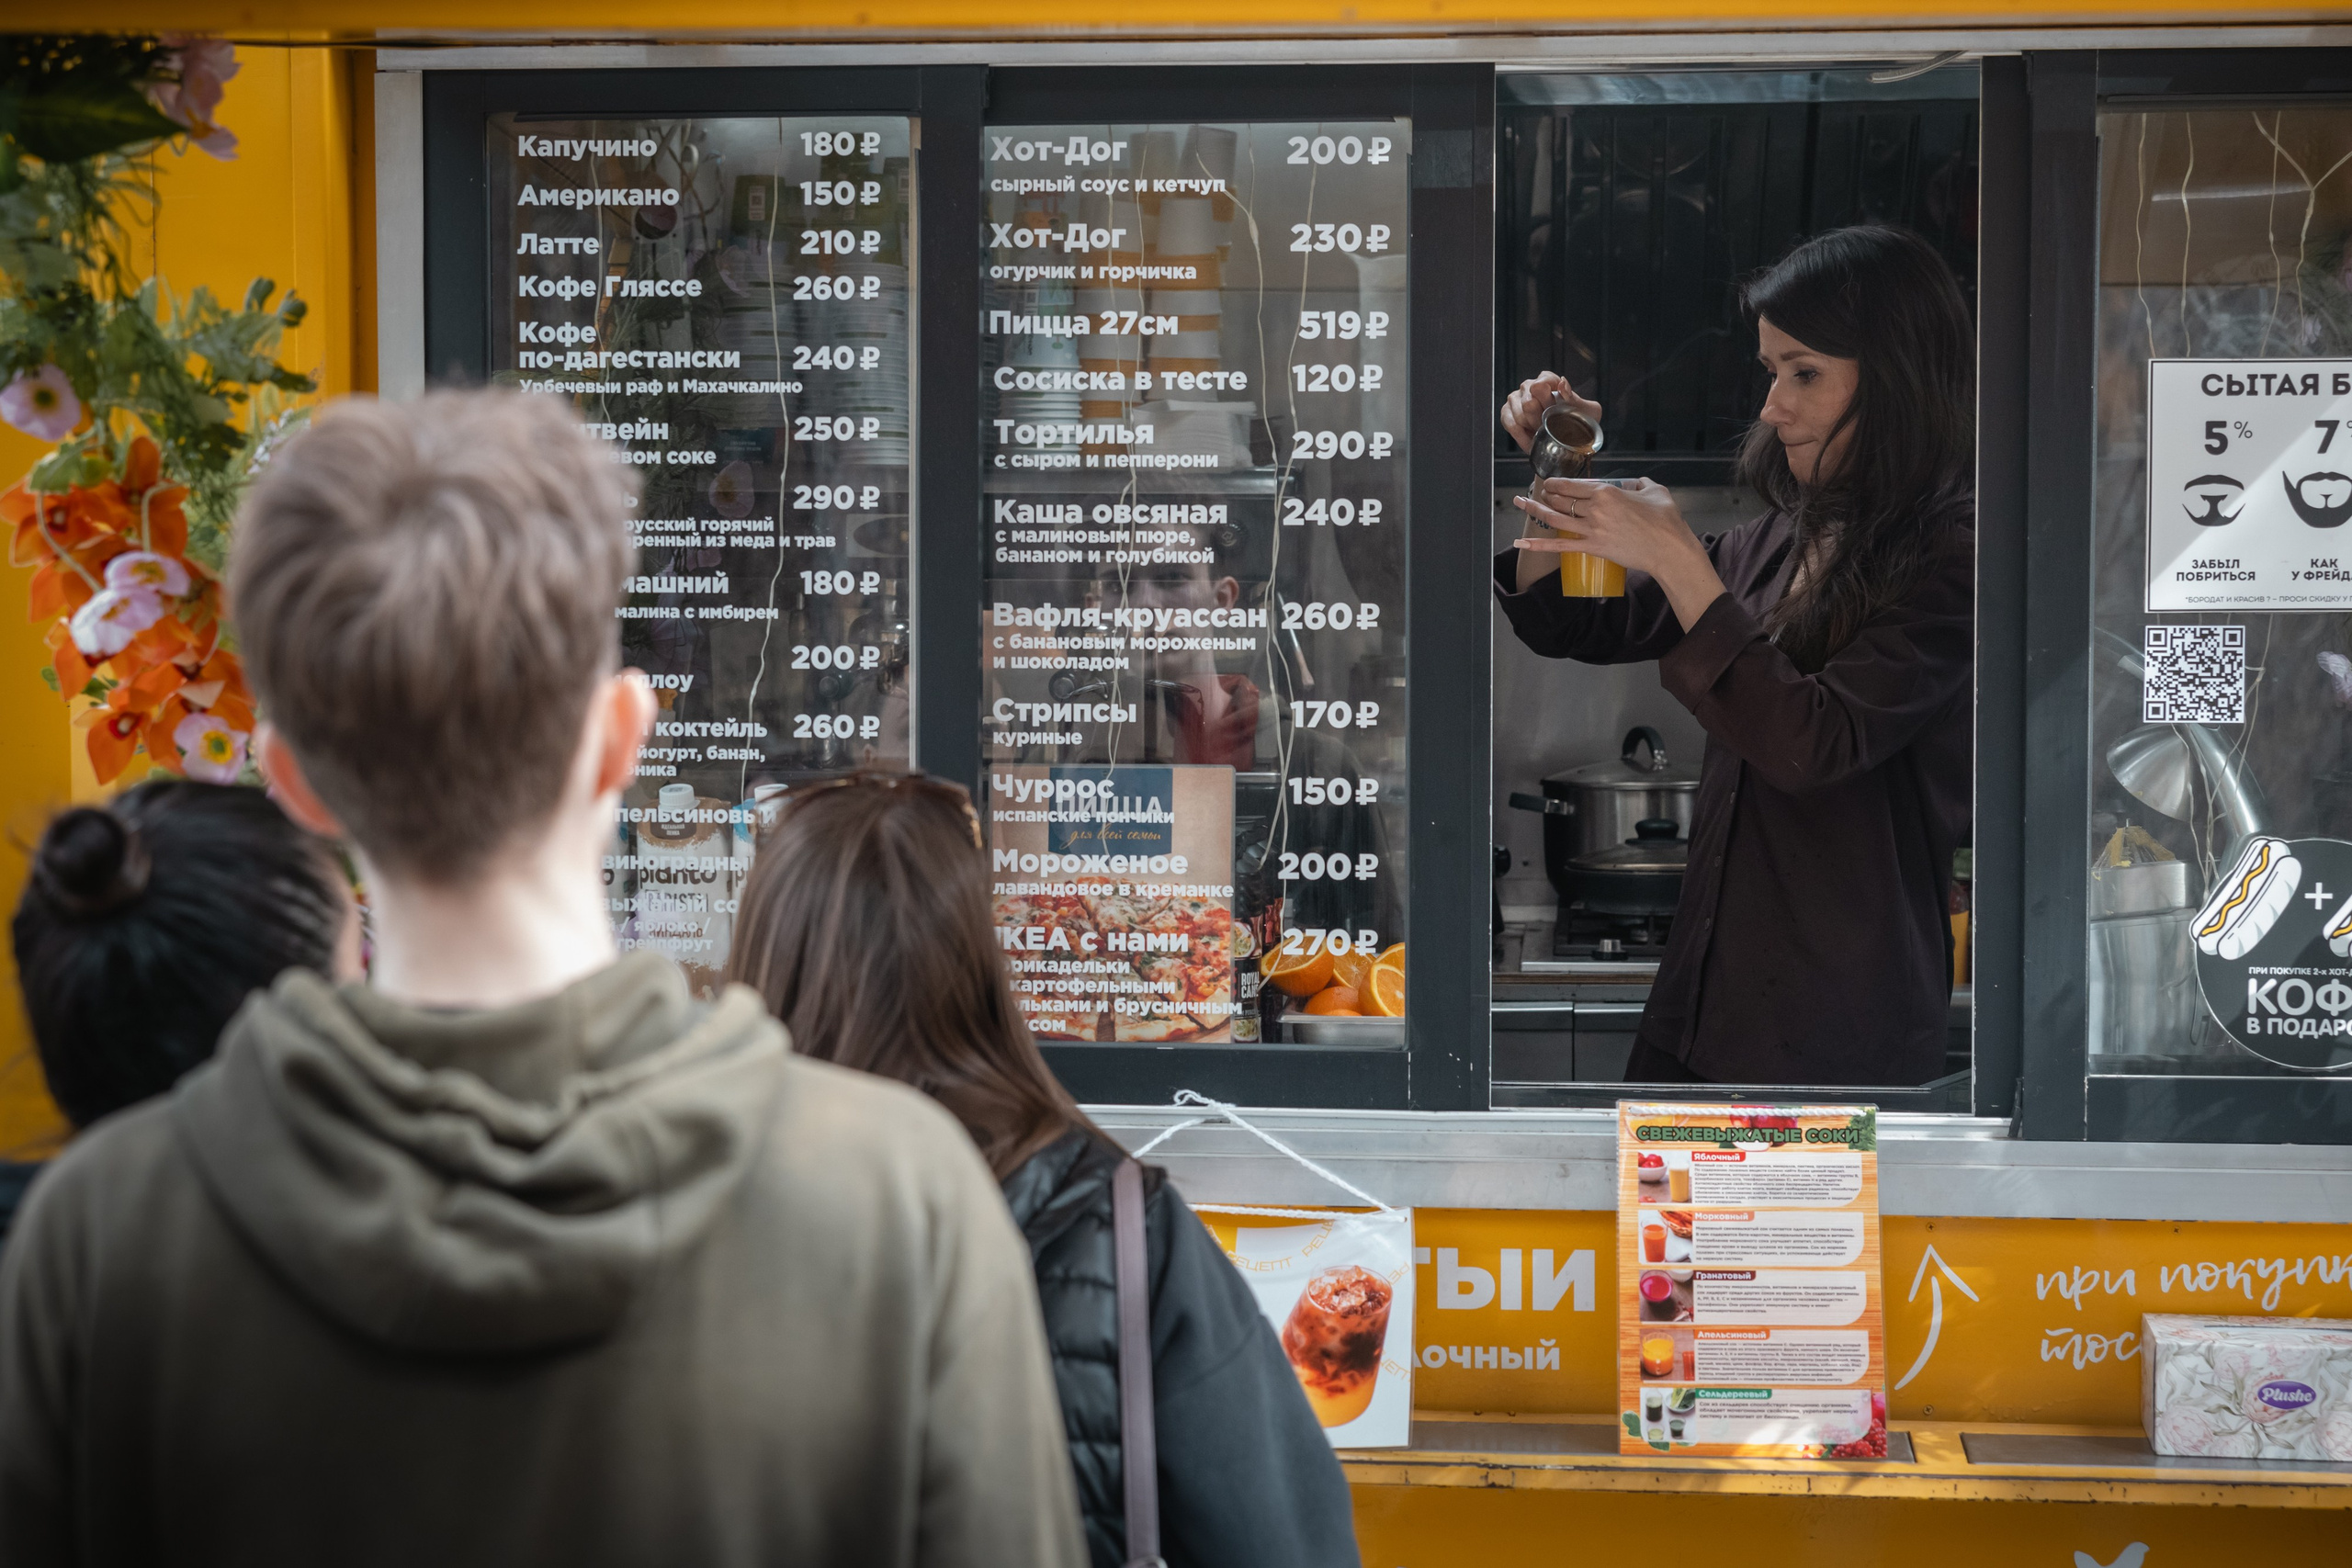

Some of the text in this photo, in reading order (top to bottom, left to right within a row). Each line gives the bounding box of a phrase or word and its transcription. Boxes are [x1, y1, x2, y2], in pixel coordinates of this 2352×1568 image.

[518, 135, 658, 159] Капучино
[989, 137, 1127, 165] Хот-Дог
[990, 175, 1226, 194] сырный соус и кетчуп
[517, 184, 680, 209] Американо
[516, 233, 600, 254] Латте
[989, 223, 1126, 253] Хот-Дог
[989, 265, 1196, 282] огурчик и горчичка
[518, 276, 596, 301] Кофе
[605, 276, 702, 298] Гляссе
[989, 311, 1090, 338] Пицца
[1100, 311, 1179, 335] 27см
[518, 321, 596, 347] Кофе
[519, 349, 741, 371] по-дагестански
[626, 378, 662, 396] раф
[667, 381, 678, 393] и
[683, 379, 803, 394] Махачкалино
[994, 367, 1125, 390] Сосиска
[1135, 371, 1153, 390] в
[1160, 371, 1248, 390] тесте
[2201, 373, 2320, 397] СЫТАЯ
[581, 417, 669, 441] твейн
[993, 420, 1154, 447] Тортилья
[666, 450, 717, 465] соке
[994, 455, 1218, 469] с сыром и пепперони
[994, 500, 1086, 525] Каша
[1092, 502, 1227, 525] овсяная
[701, 516, 775, 533] горячий
[706, 536, 727, 547] из
[730, 536, 775, 548] меда
[779, 536, 790, 547] и
[795, 536, 836, 550] трав
[995, 530, 1195, 547] с малиновым пюре,
[995, 547, 1215, 566] бананом и голубикой
[2192, 558, 2338, 570] ЗАБЫЛ КАК
[619, 570, 729, 593] машний
[2176, 569, 2352, 581] ПОБРИТЬСЯ У ФРЕЙД
[2309, 595, 2341, 604] СКИДКУ
[614, 605, 778, 620] малина с имбирем
[993, 602, 1267, 631] Вафля-круассан
[993, 634, 1256, 652] с банановым мороженым
[993, 655, 1129, 671] и шоколадом
[992, 697, 1136, 727] Стрипсы
[656, 717, 768, 738] коктейль
[992, 731, 1083, 747] куриные
[637, 744, 765, 762] йогурт, банан,
[992, 773, 1114, 802] Чуррос
[993, 809, 1175, 825] испанские пончики
[993, 848, 1189, 876] Мороженое
[992, 882, 1234, 900] лавандовое в креманке
[714, 899, 739, 913] со
[1080, 931, 1098, 951] с
[1107, 932, 1189, 953] нами
[1009, 960, 1130, 975] рикадельки
[2269, 967, 2311, 976] ПОКУПКЕ
[1010, 977, 1175, 996] картофельными
[1019, 999, 1091, 1012] льками
[1097, 999, 1108, 1012] и
[1114, 998, 1242, 1016] брусничным
[2247, 1017, 2261, 1034] В
[1636, 1125, 1860, 1144] СВЕЖЕВЫЖАТЫЕ СОКИ
[1693, 1153, 1741, 1162] Яблочный
[1694, 1213, 1749, 1222] Морковный
[1696, 1271, 1752, 1280] Гранатовый
[2036, 1266, 2136, 1311] при
[1697, 1330, 1767, 1340] Апельсиновый
[1415, 1338, 1560, 1371] очный
[1699, 1390, 1769, 1400] Сельдереевый
[2261, 1387, 2313, 1404] Plushe
